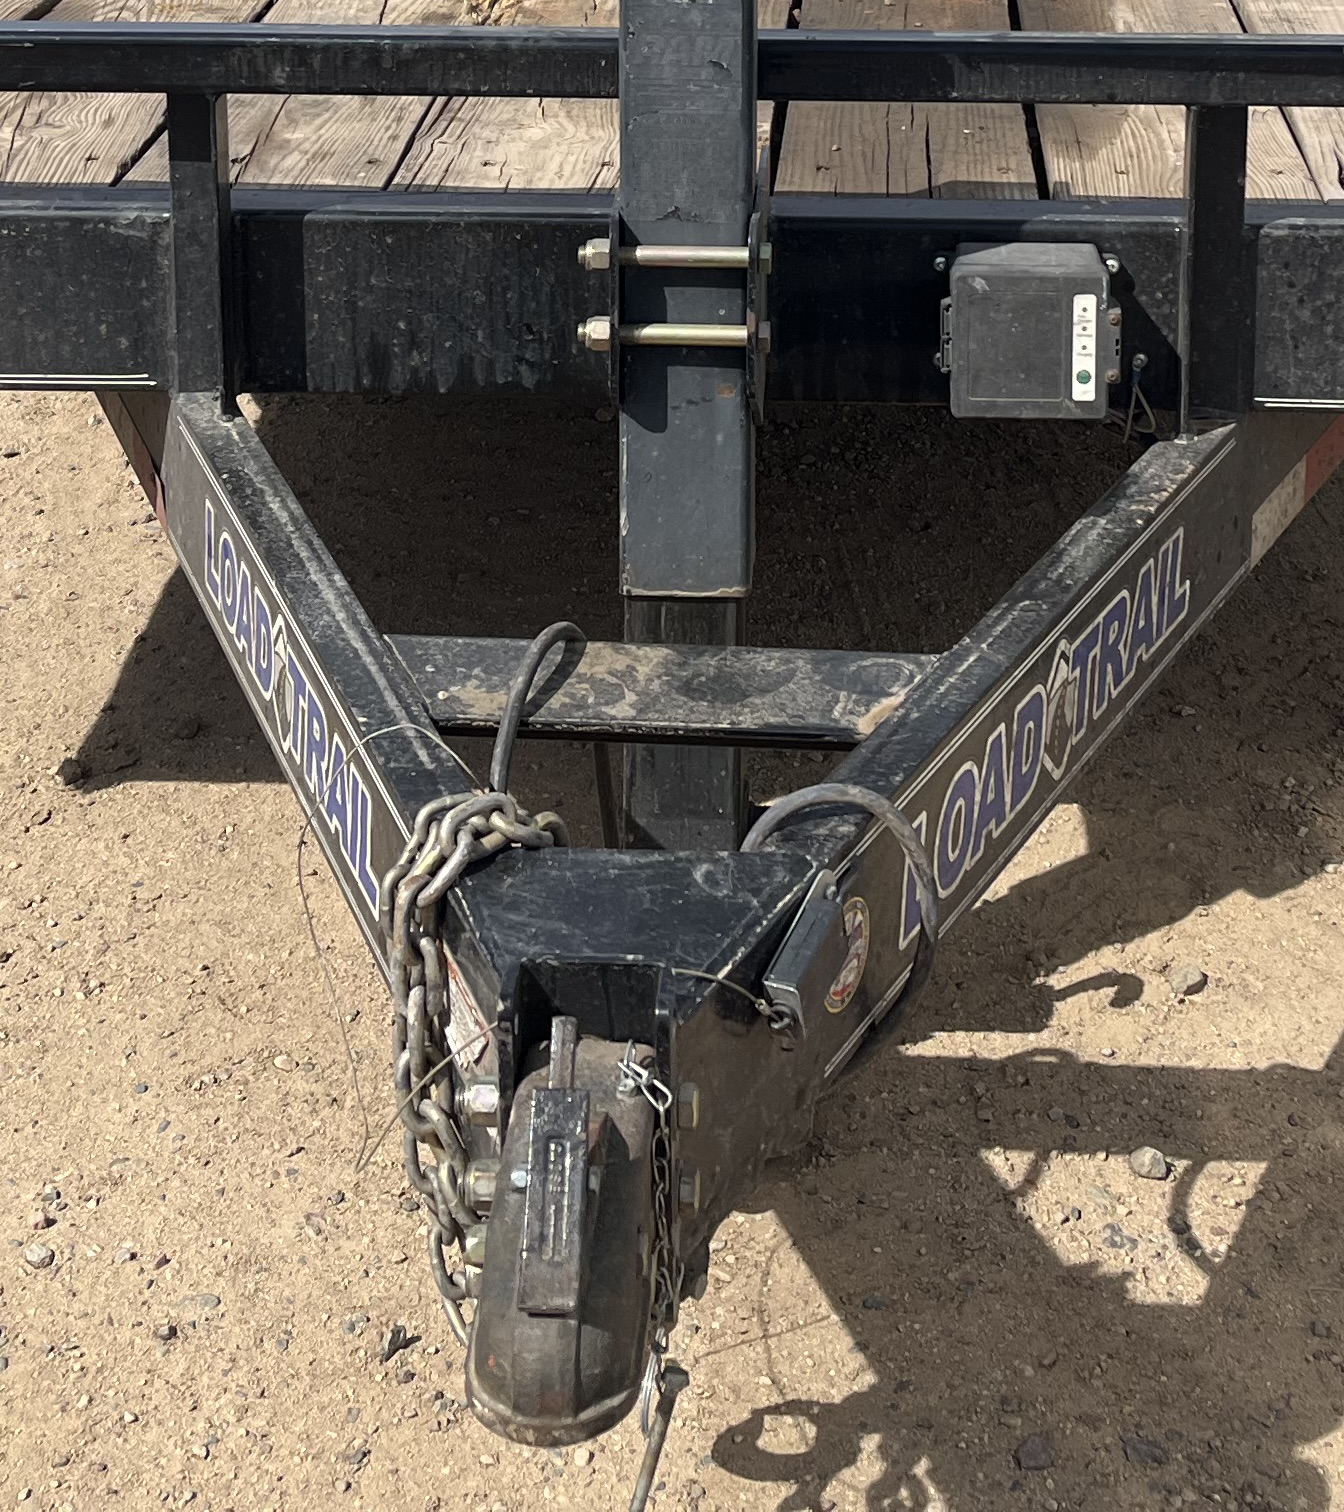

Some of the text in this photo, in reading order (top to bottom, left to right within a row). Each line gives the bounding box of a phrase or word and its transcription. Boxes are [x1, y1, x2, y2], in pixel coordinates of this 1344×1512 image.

[204, 498, 380, 922] LOAD TRAIL
[1069, 525, 1190, 745] TRAIL
